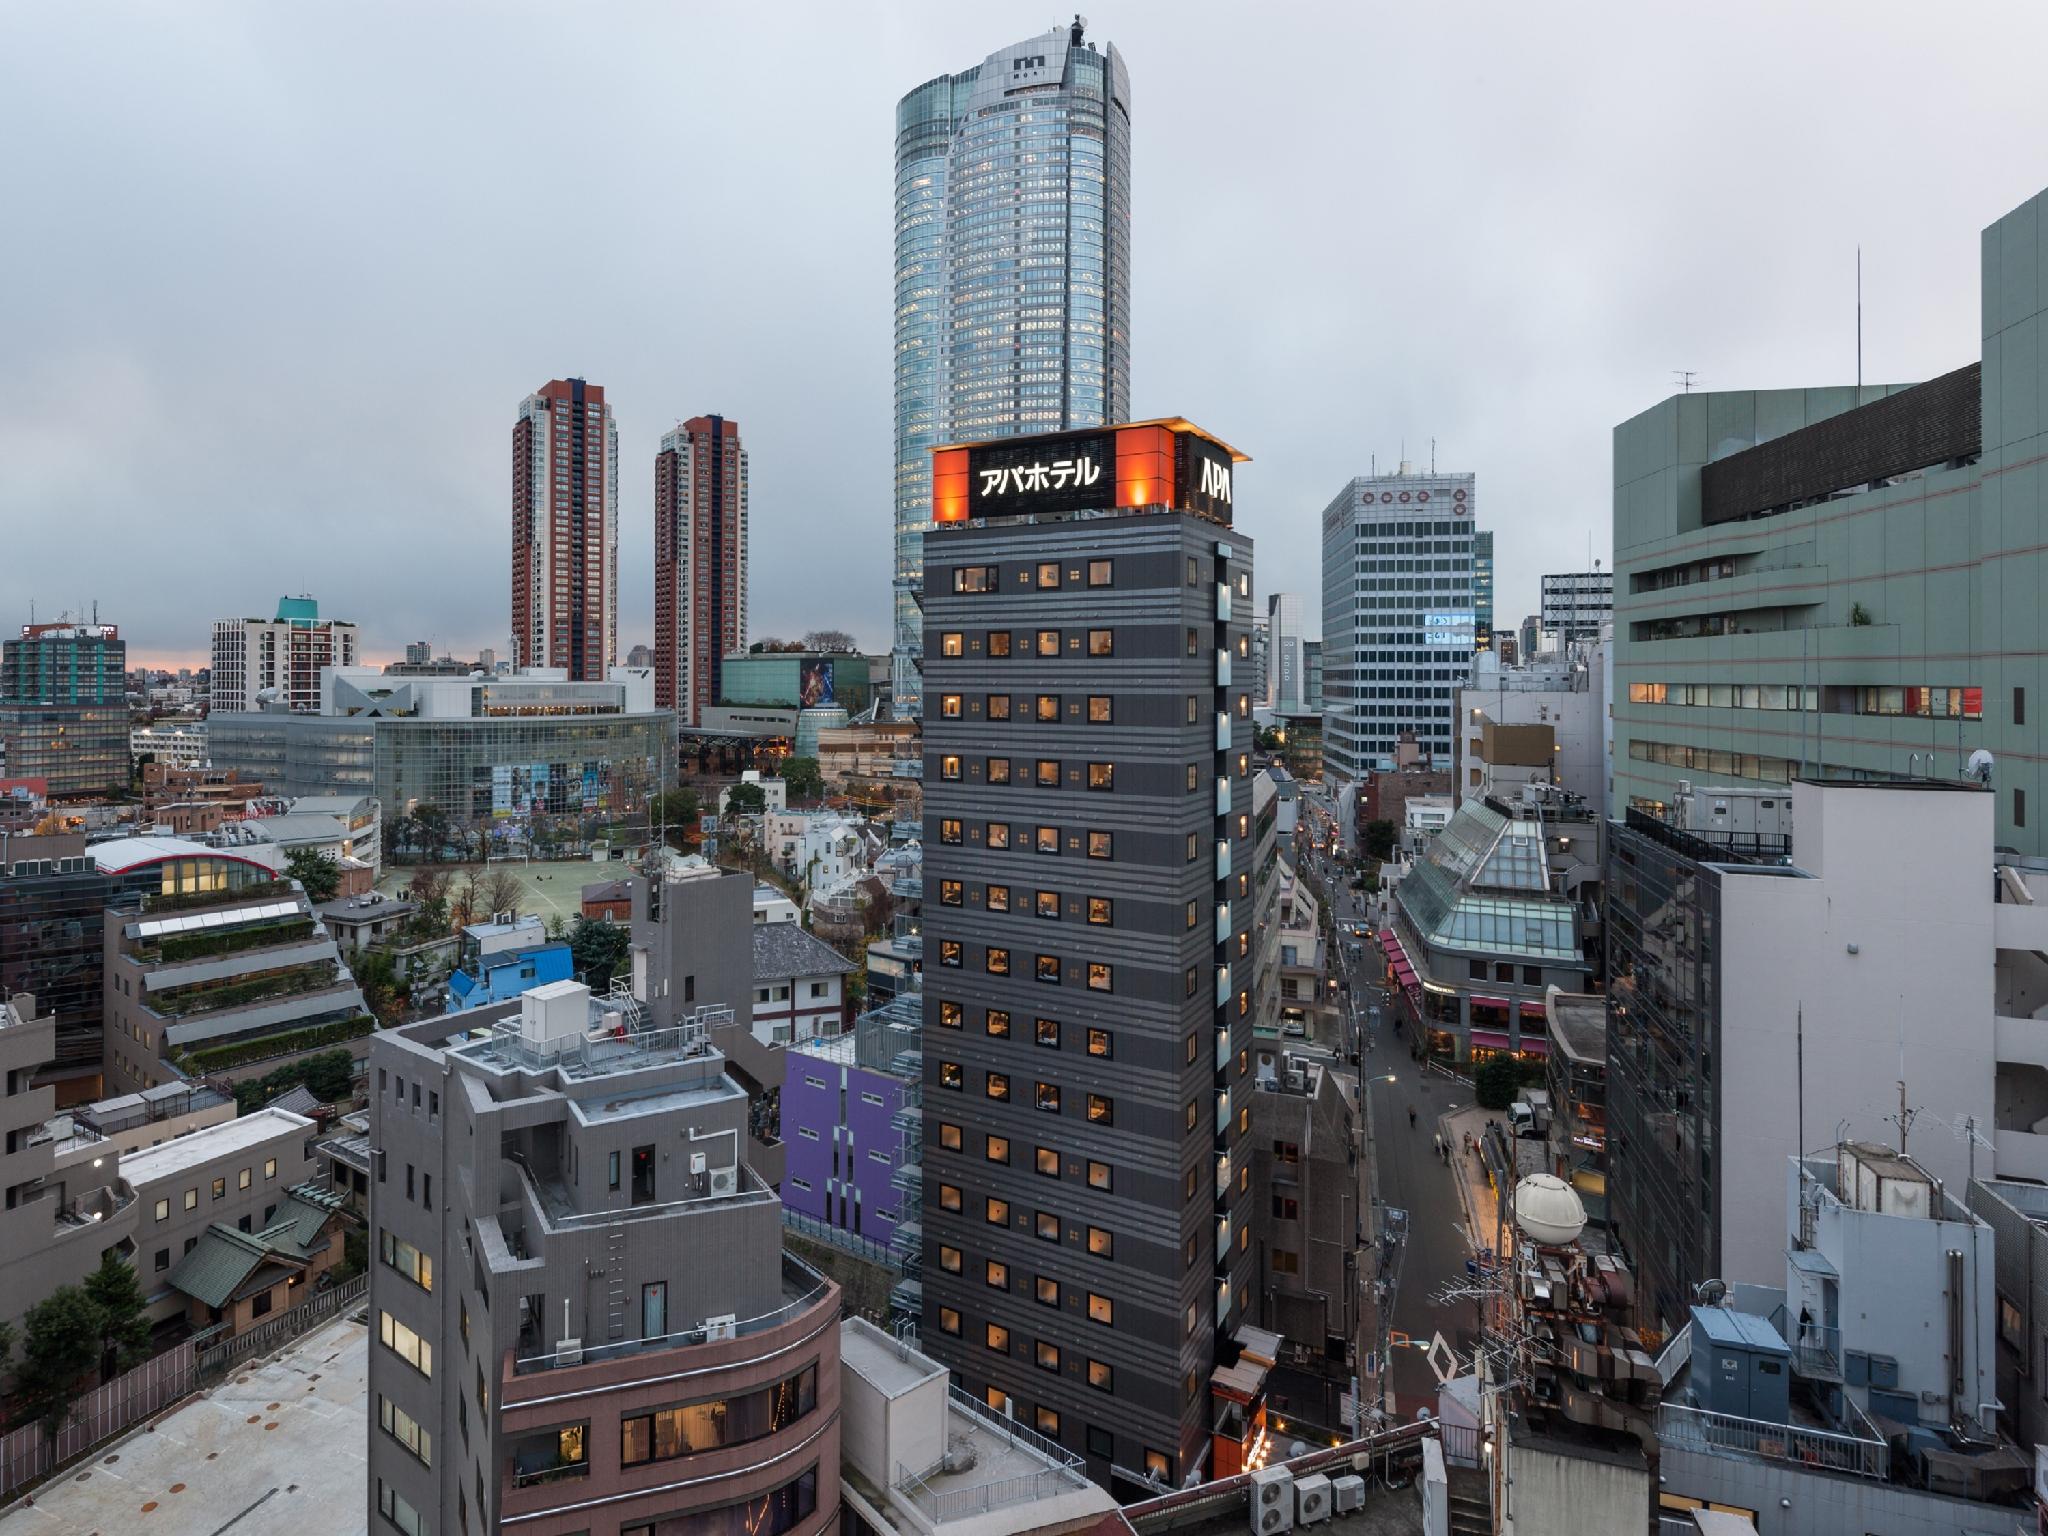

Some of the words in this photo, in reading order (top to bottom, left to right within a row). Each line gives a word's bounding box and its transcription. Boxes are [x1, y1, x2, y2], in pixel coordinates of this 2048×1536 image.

[980, 457, 1100, 496] アパホテル
[1200, 456, 1232, 505] APA
